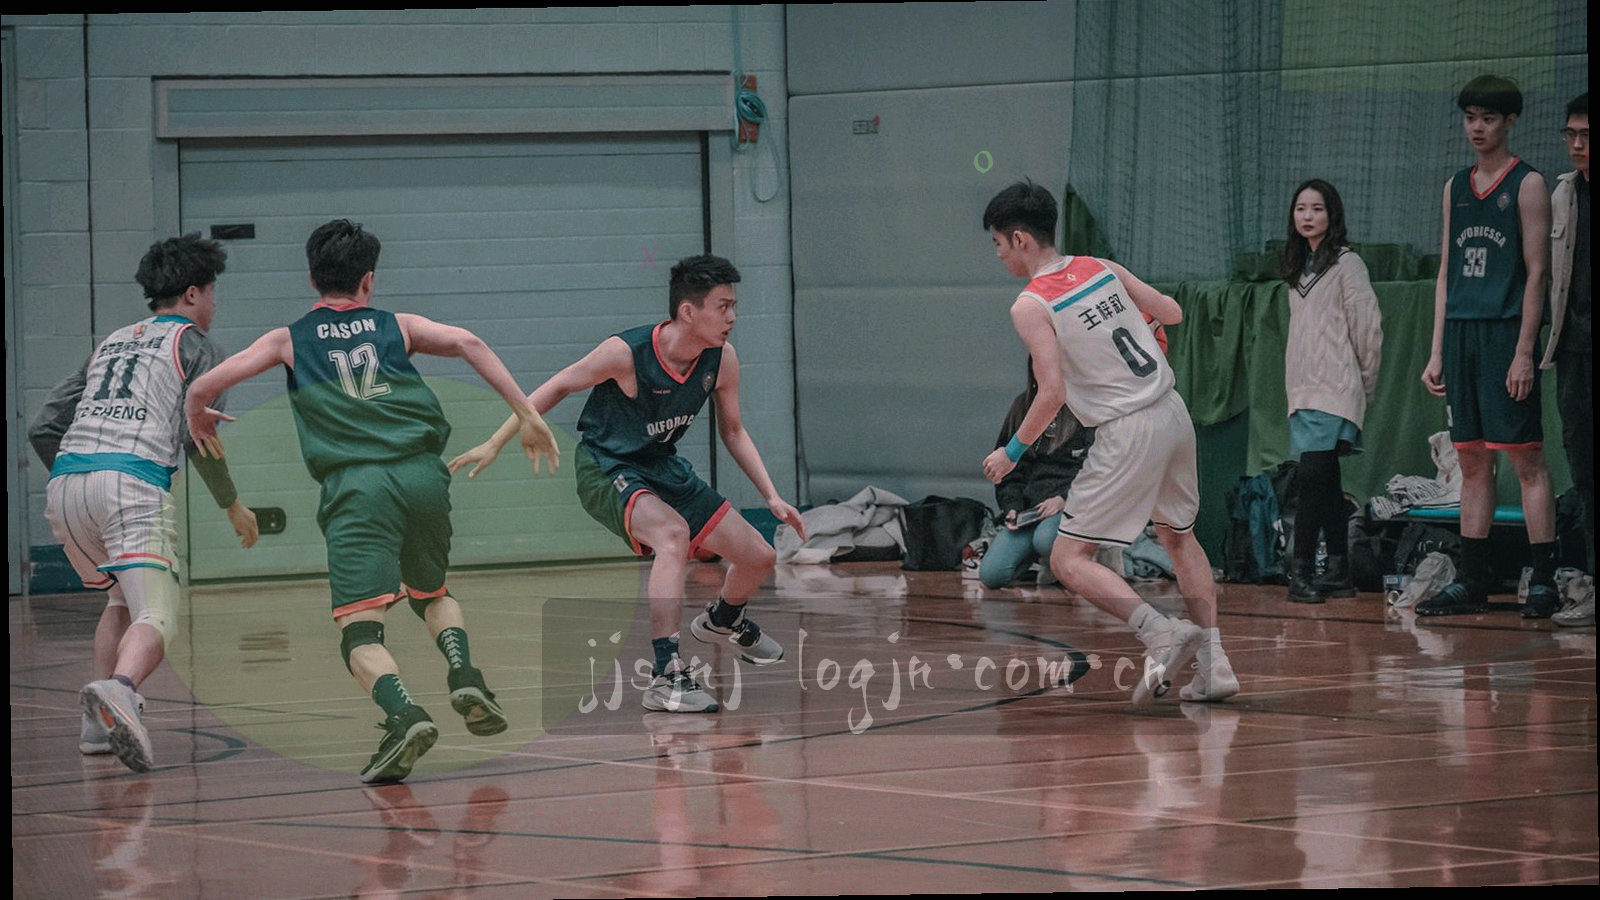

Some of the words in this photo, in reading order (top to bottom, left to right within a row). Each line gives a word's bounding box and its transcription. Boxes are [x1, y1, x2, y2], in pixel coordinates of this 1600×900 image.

[1462, 246, 1488, 278] 33
[316, 318, 376, 339] CASON
[1111, 326, 1158, 377] 0
[92, 353, 140, 401] 11
[328, 342, 392, 400] 12
